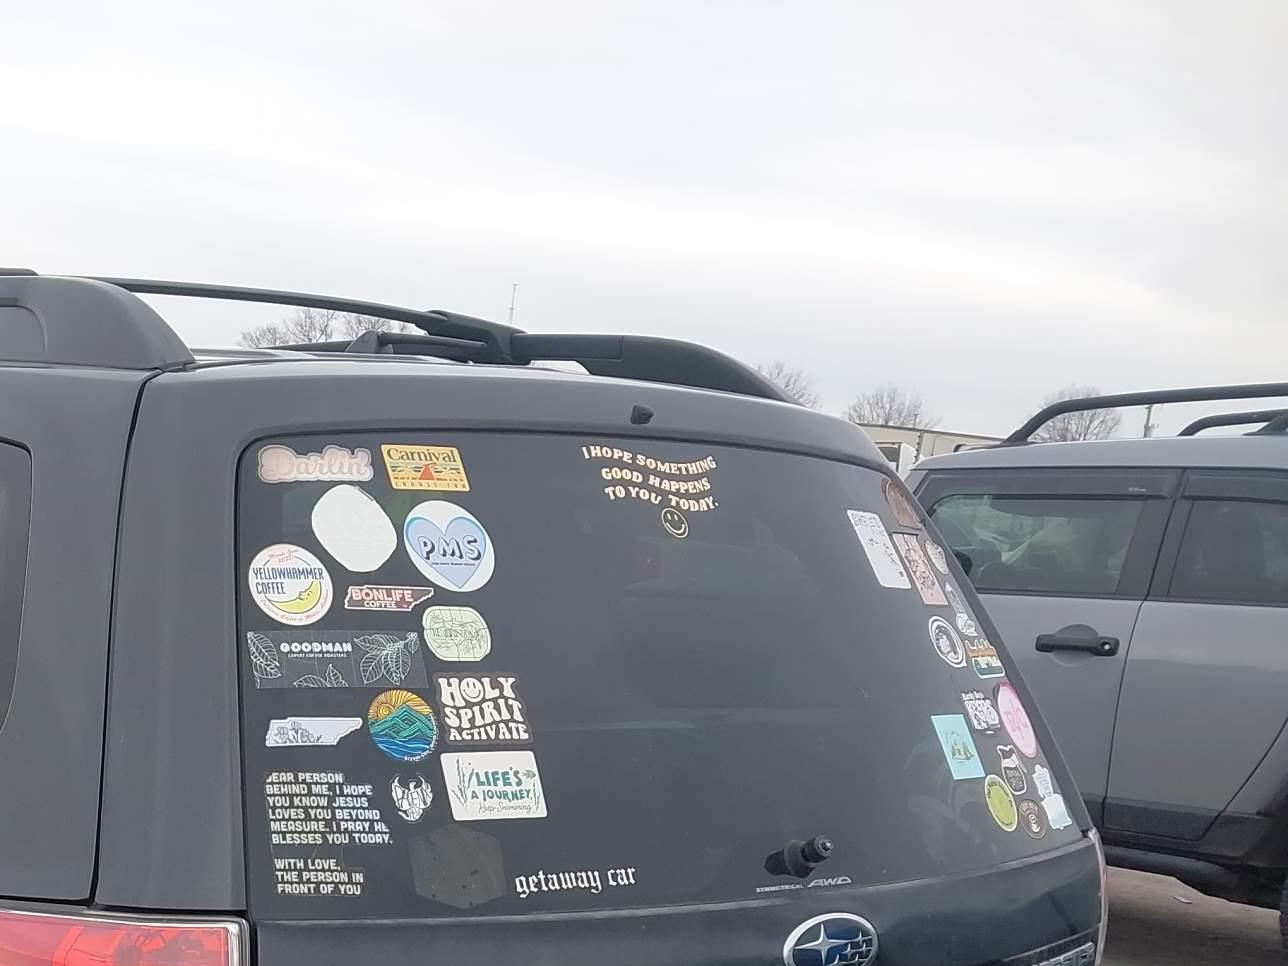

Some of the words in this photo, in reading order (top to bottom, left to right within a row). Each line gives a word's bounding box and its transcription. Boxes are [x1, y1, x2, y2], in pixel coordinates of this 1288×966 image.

[387, 447, 456, 463] Carnival
[582, 446, 590, 459] I
[590, 446, 633, 463] HOPE
[636, 454, 717, 475] SOMETHING
[601, 467, 643, 483] GOOD
[648, 475, 711, 493] HAPPENS
[604, 485, 626, 500] TO
[628, 486, 662, 504] YOU
[668, 494, 719, 511] TODAY.
[418, 535, 481, 561] PMS
[252, 567, 324, 580] YELLOWHAMMER
[255, 582, 286, 595] COFFEE
[351, 588, 413, 601] BONLIFE
[363, 600, 397, 608] COFFEE
[280, 642, 352, 653] GOODMAN
[438, 677, 516, 707] HOLY
[444, 699, 524, 728] SPIRIT
[449, 722, 529, 740] ACTIVATE
[298, 773, 343, 783] PERSON
[475, 767, 523, 787] LIFE'S
[266, 784, 308, 795] BEHIND
[312, 784, 333, 796] ME,
[336, 785, 340, 795] I
[343, 785, 373, 795] HOPE
[472, 790, 479, 800] A
[267, 796, 290, 807] YOU
[293, 796, 328, 807] KNOW
[332, 797, 368, 807] JESUS
[269, 808, 305, 819] LOVES
[308, 808, 331, 819] YOU
[335, 809, 380, 820] BEYOND
[270, 821, 329, 831] MEASURE.
[333, 821, 337, 831] I
[340, 821, 370, 832] PRAY
[272, 834, 323, 844] BLESSES
[326, 833, 349, 844] YOU
[274, 859, 304, 869] WITH
[308, 859, 341, 871] LOVE,
[275, 871, 299, 882] THE
[302, 872, 348, 882] PERSON
[352, 872, 363, 883] IN
[515, 870, 602, 898] getaway
[607, 867, 636, 886] car
[808, 876, 852, 888] AWD
[277, 884, 316, 894] FRONT
[320, 884, 334, 894] OF
[338, 884, 361, 894] YOU
